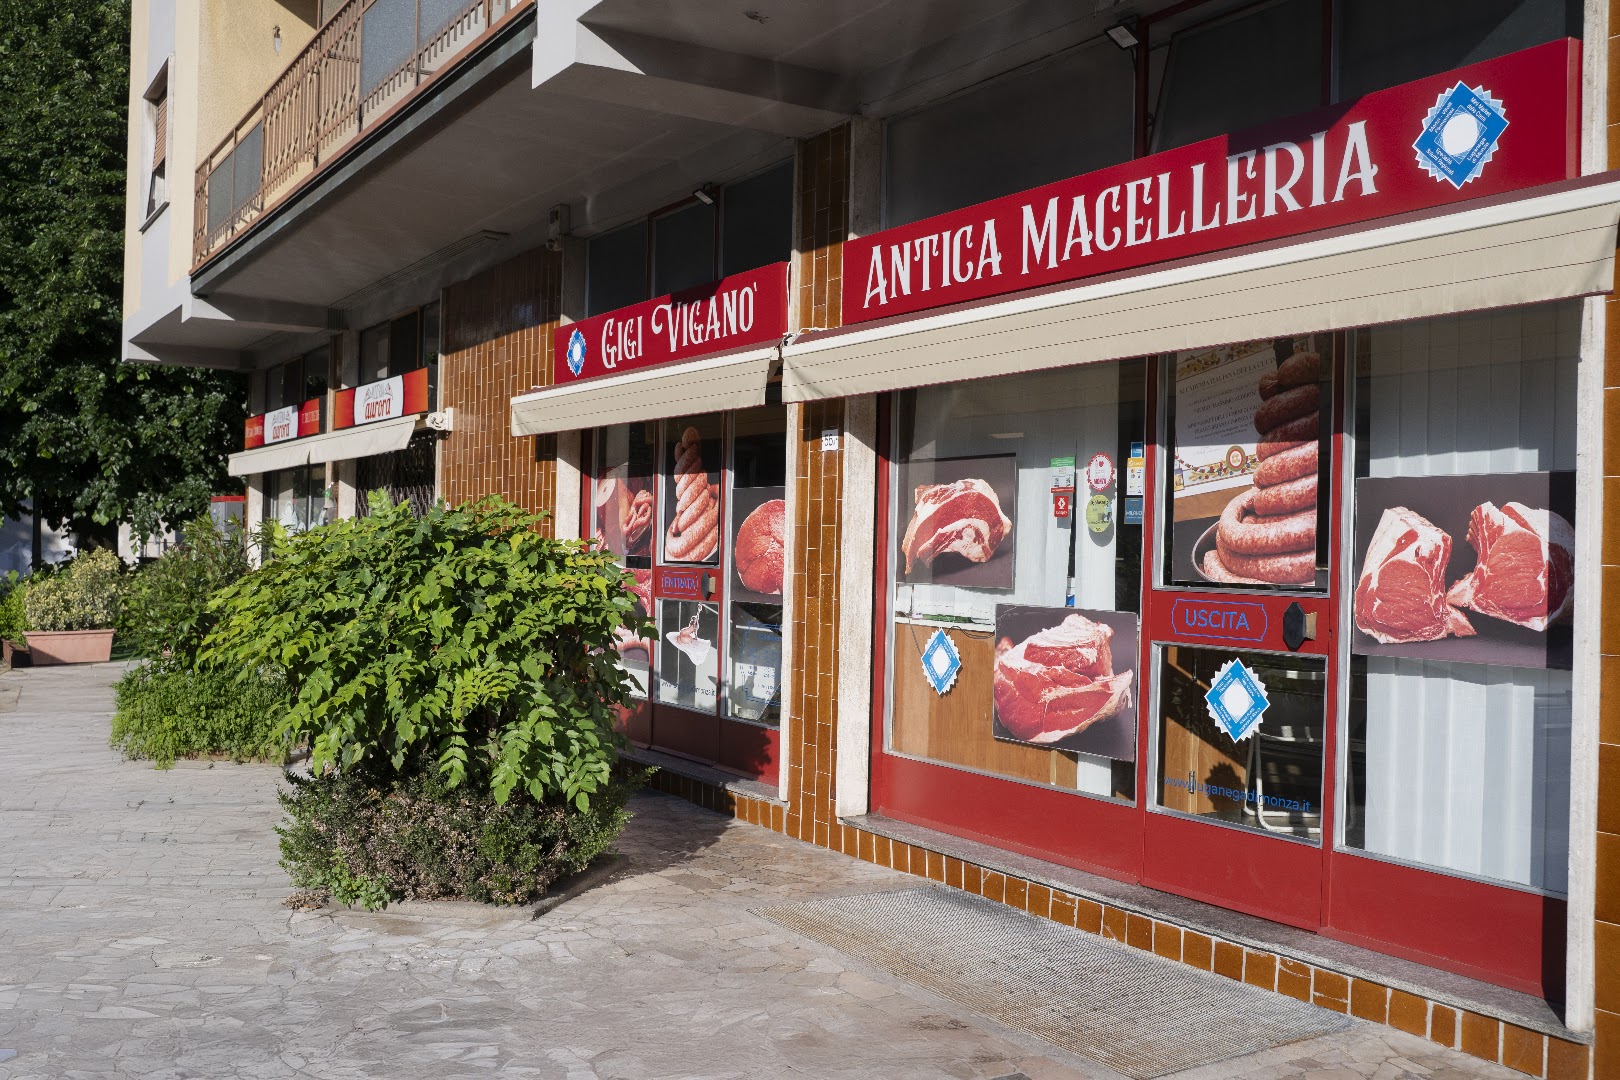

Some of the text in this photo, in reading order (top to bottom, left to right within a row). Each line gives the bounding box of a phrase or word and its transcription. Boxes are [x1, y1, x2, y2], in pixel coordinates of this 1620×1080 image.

[862, 119, 1380, 310] ANTICA MACELLERIA
[601, 316, 643, 369] GIGI
[365, 397, 391, 420] aurora
[664, 577, 696, 590] ENTRATA
[1185, 608, 1250, 631] USCITA
[1164, 776, 1311, 813] wwwluganegadimonza.it
